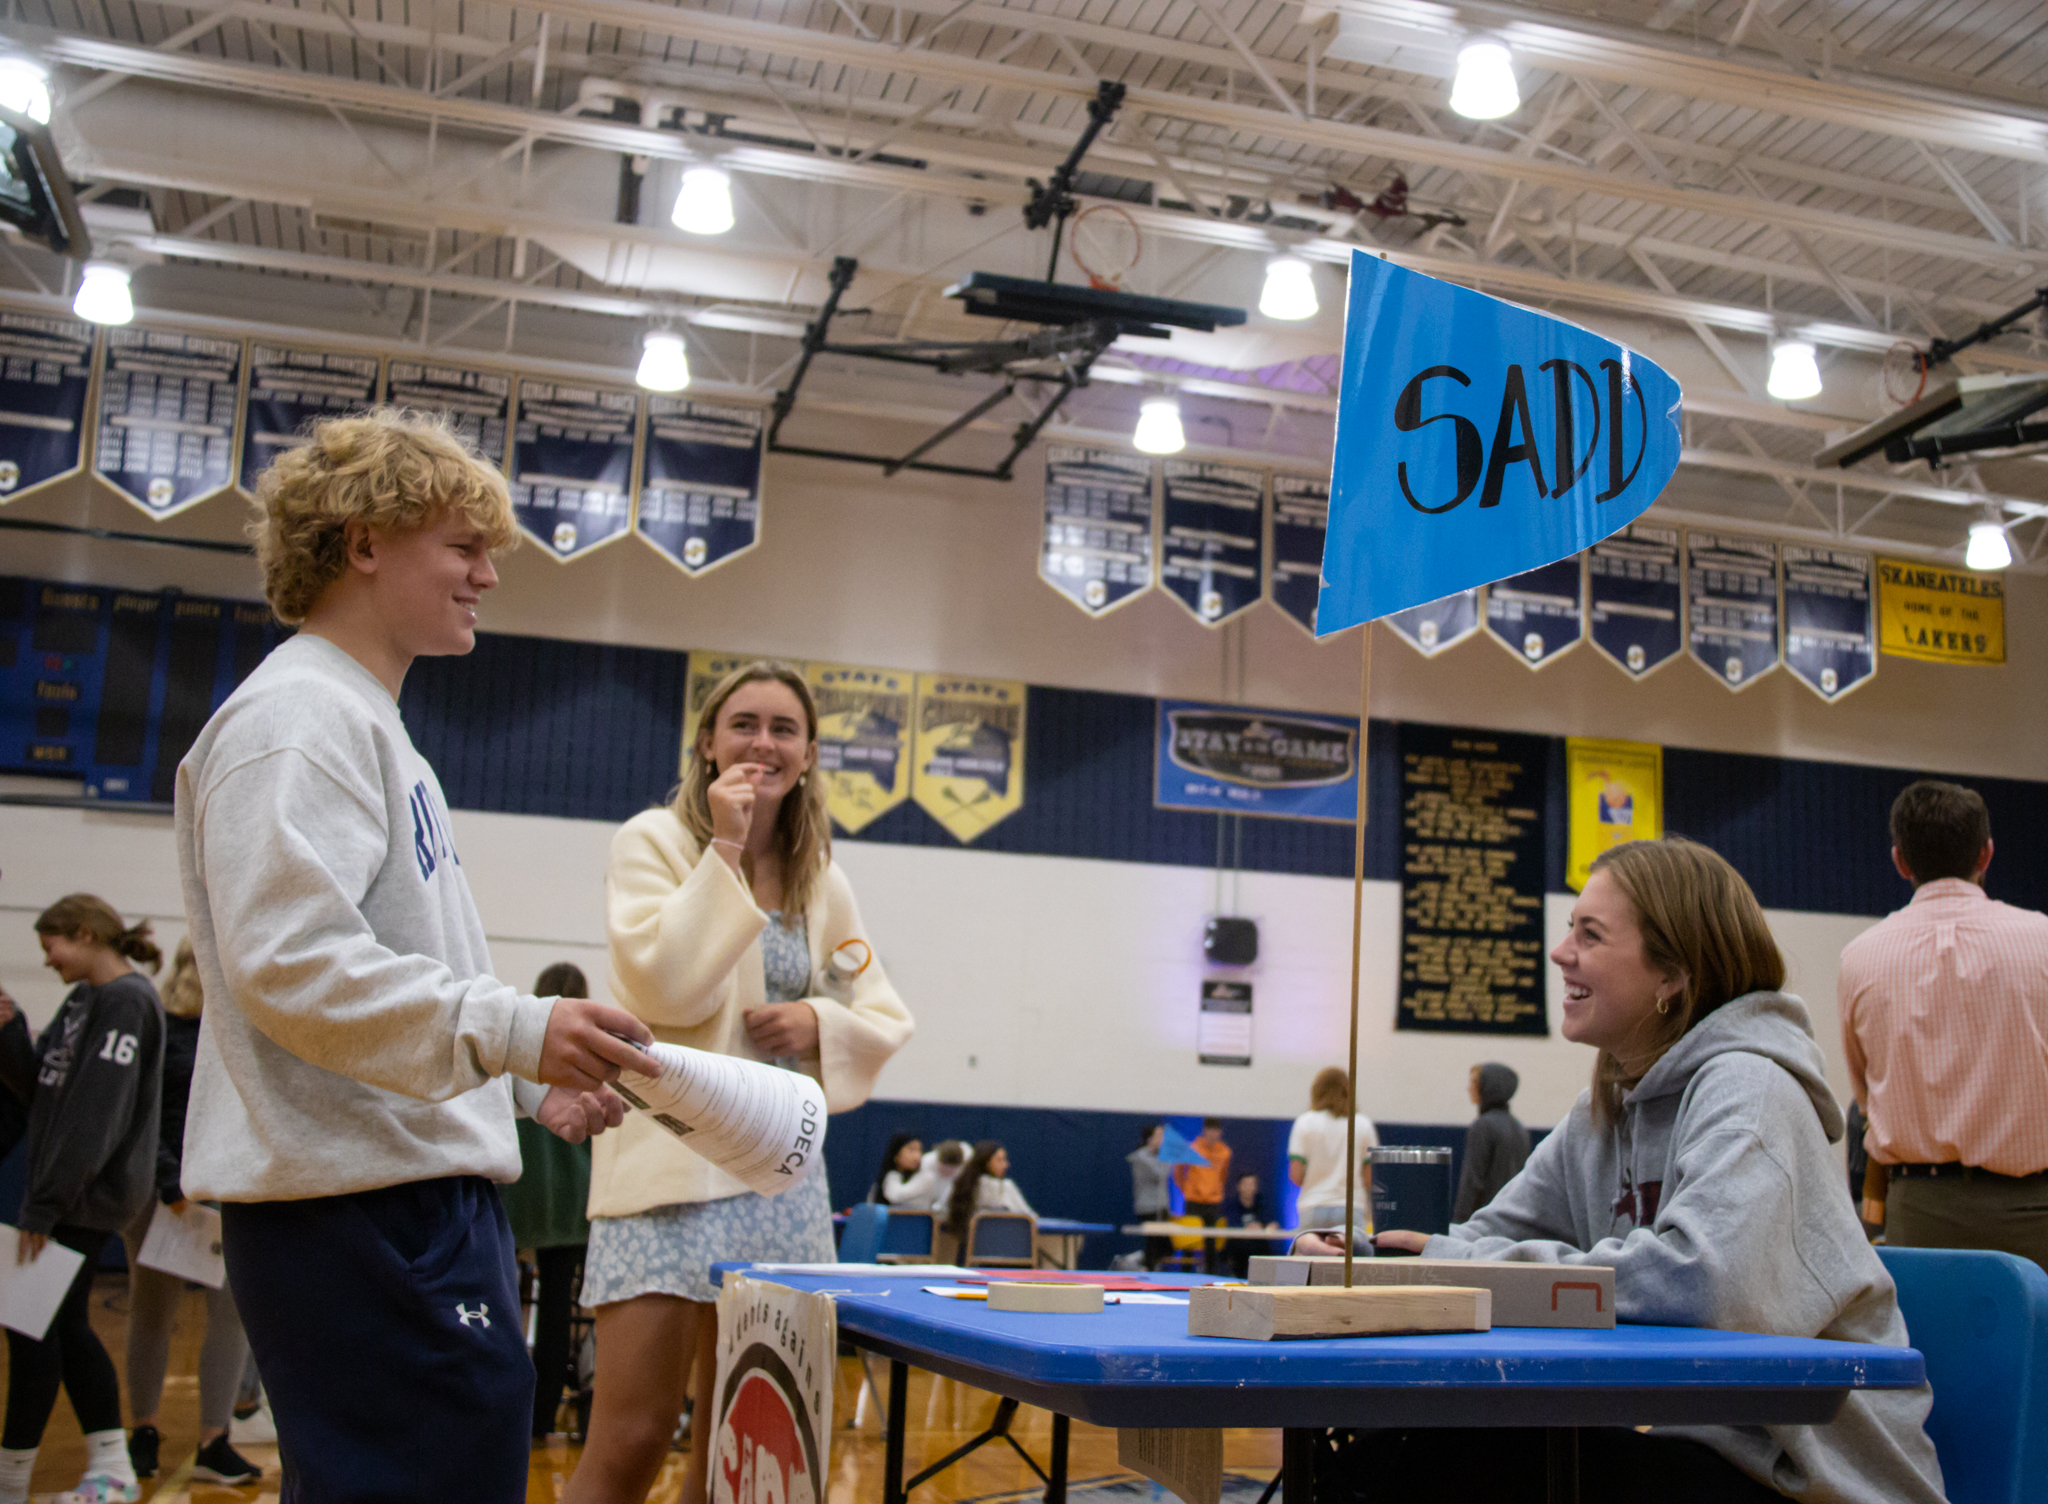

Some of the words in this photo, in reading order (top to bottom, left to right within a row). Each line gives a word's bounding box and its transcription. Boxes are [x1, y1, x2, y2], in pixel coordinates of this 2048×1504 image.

[1394, 358, 1647, 514] SADD
[1880, 563, 2003, 600] SKANEATELES
[1902, 624, 1988, 653] LAKERS
[1178, 728, 1242, 753] STAY
[1271, 738, 1347, 764] GAME
[99, 1028, 139, 1066] 16
[774, 1117, 816, 1176] DECA
